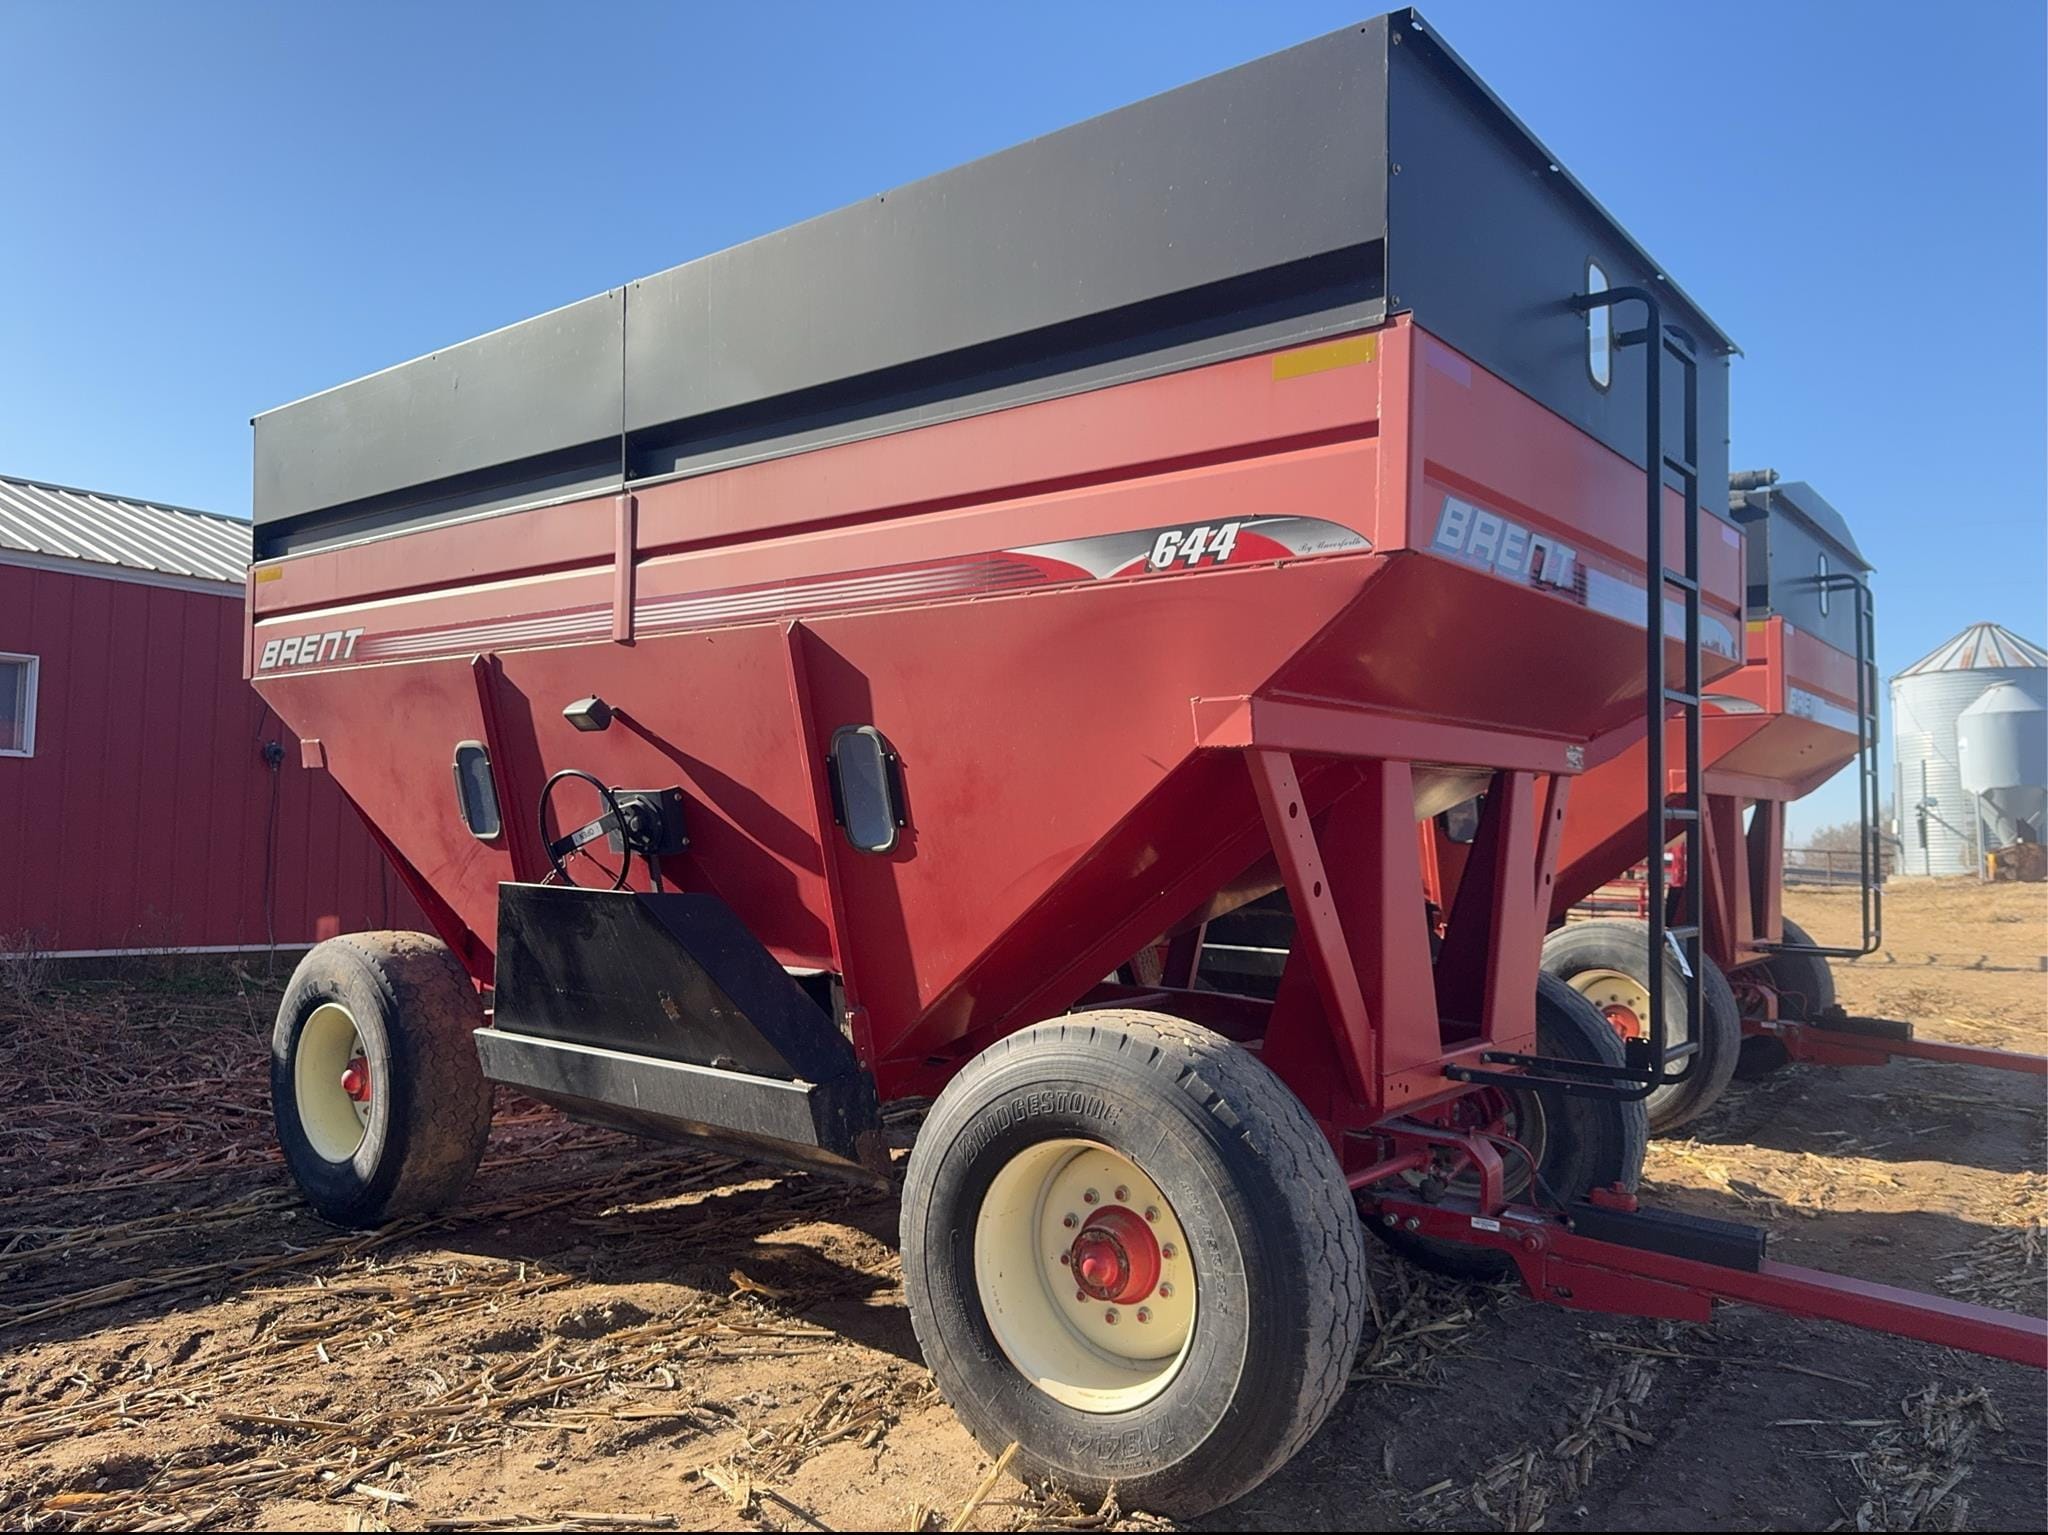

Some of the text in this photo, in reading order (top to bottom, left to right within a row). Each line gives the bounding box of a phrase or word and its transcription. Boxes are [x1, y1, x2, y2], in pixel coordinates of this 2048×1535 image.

[1151, 521, 1241, 569] 644
[1436, 495, 1578, 588] BRENT
[260, 627, 364, 670] BRENT
[958, 1089, 1123, 1166] BRIDGESTONE
